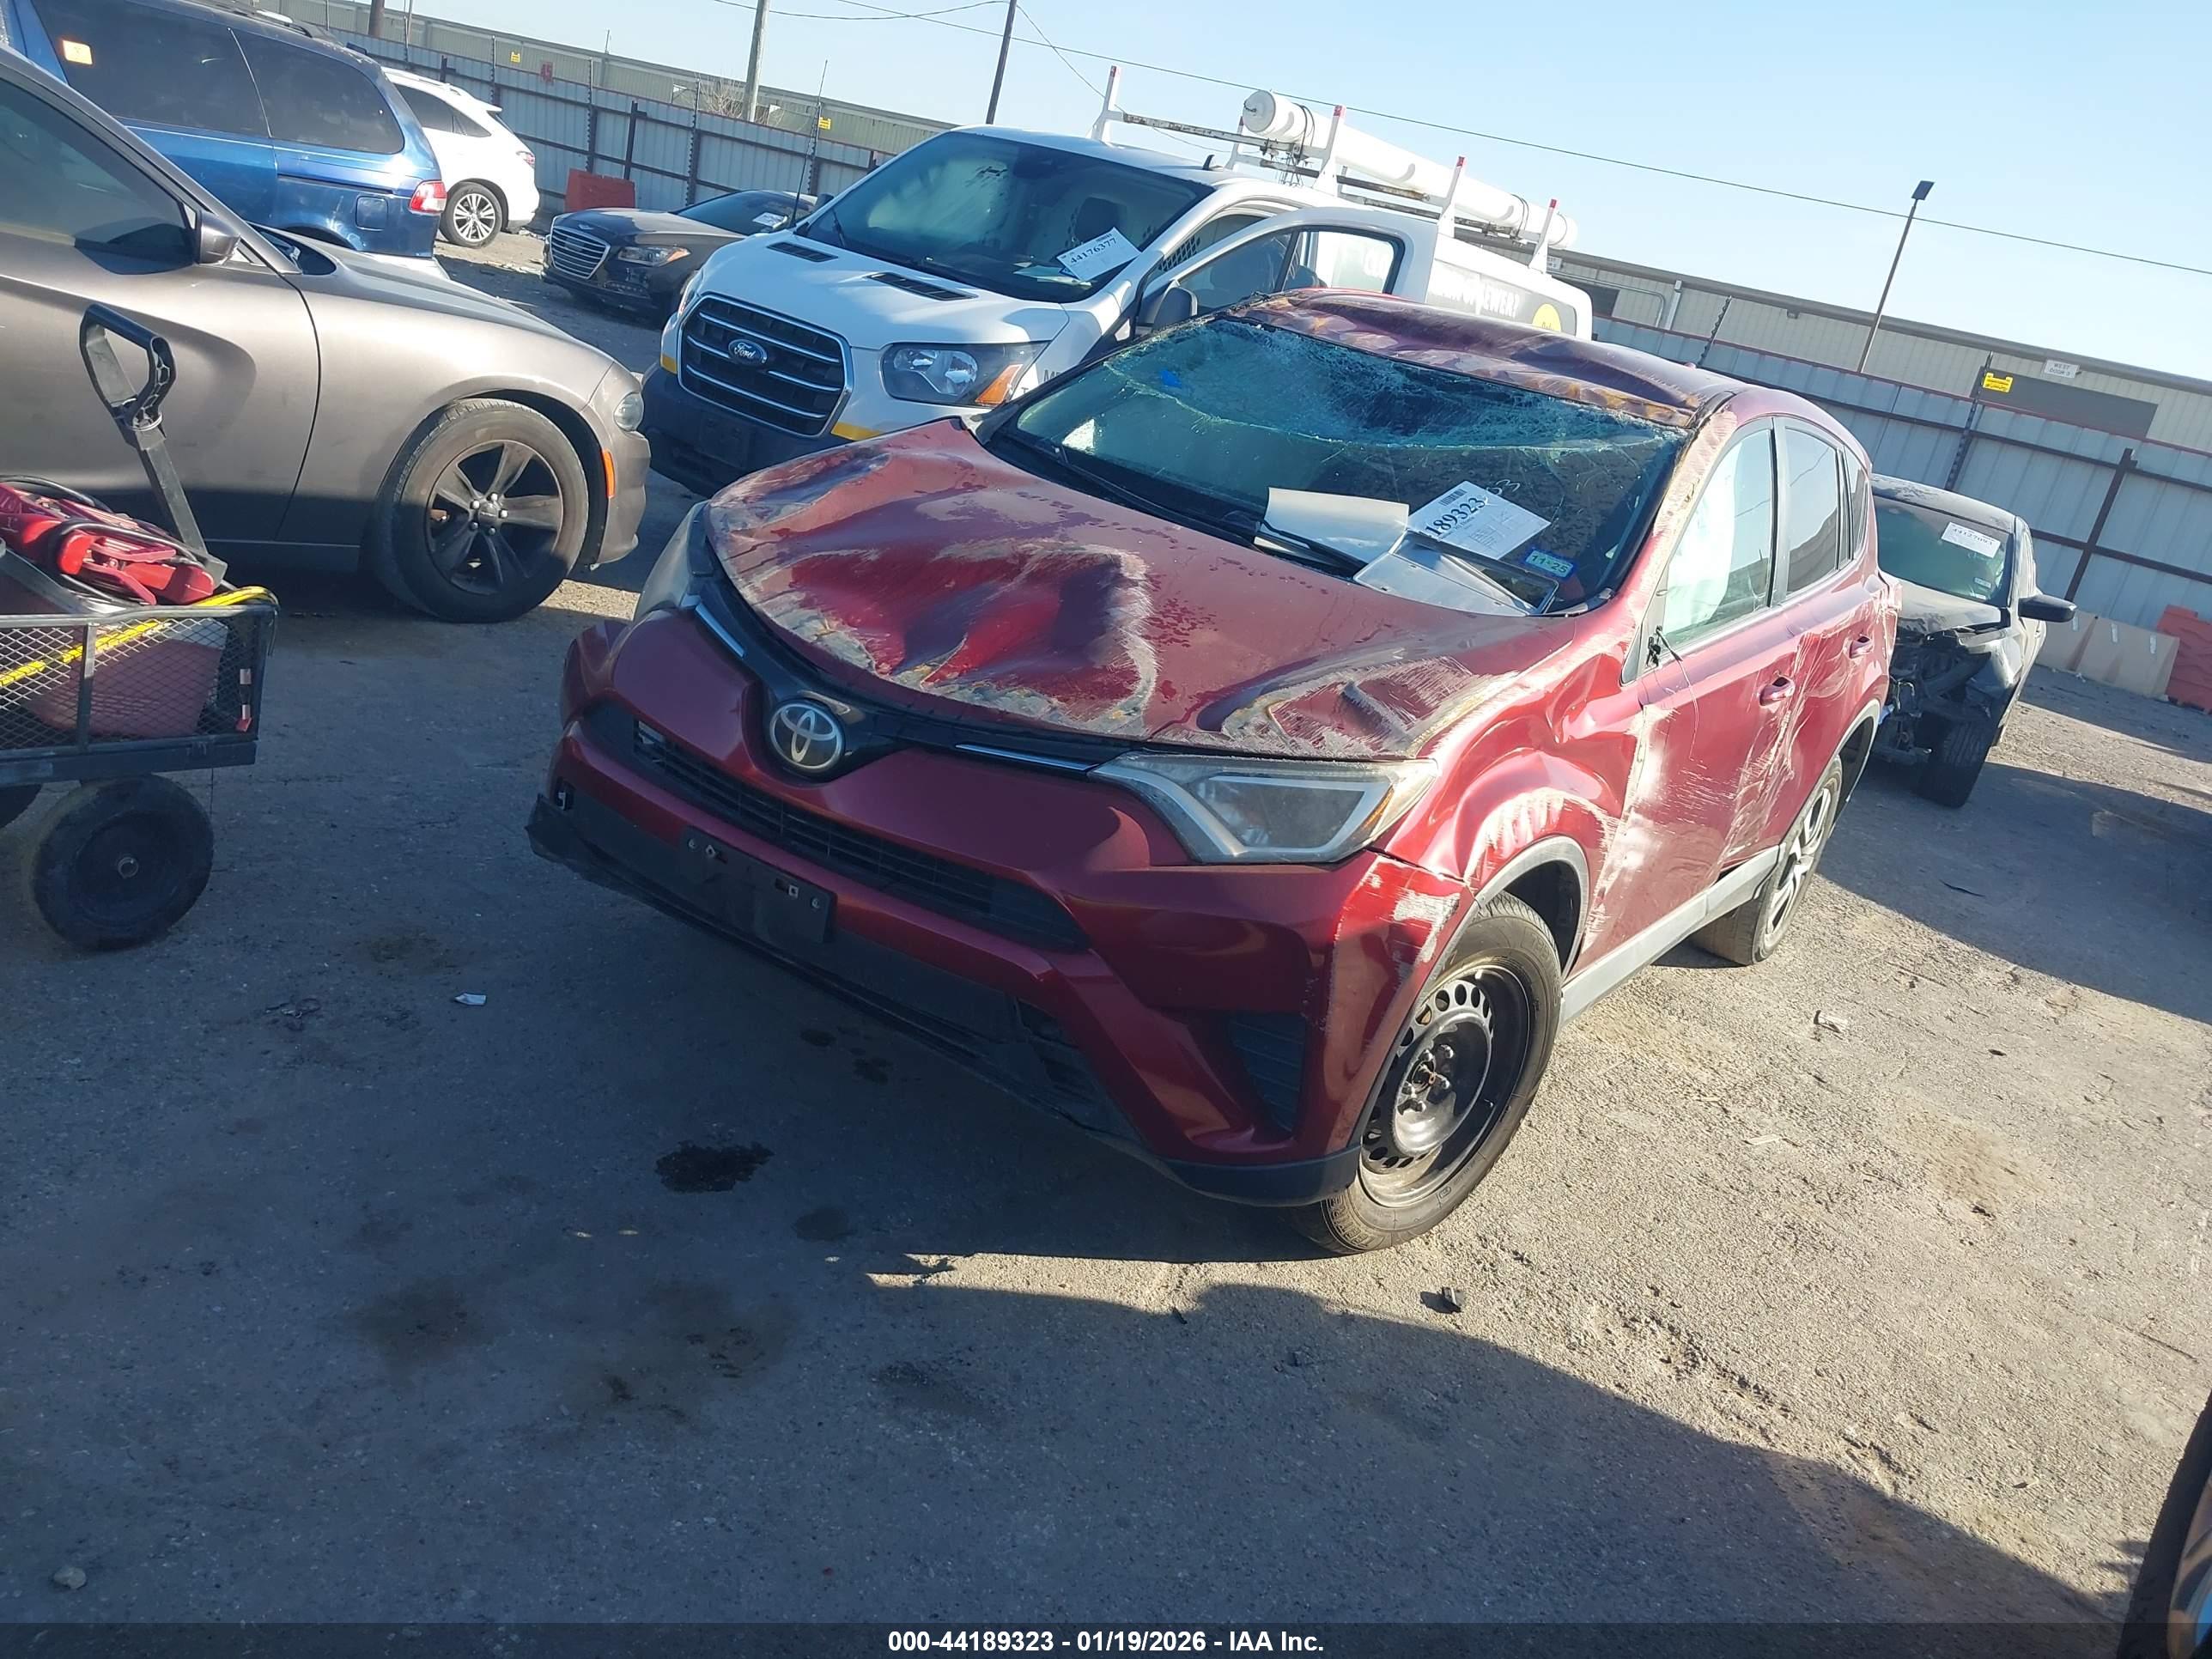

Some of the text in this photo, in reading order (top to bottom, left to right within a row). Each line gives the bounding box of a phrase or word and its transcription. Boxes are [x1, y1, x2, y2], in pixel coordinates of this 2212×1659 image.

[1070, 237, 1117, 264] 44176377
[733, 342, 757, 359] Ford
[1422, 496, 1486, 537] 189323
[1551, 562, 1569, 574] 25
